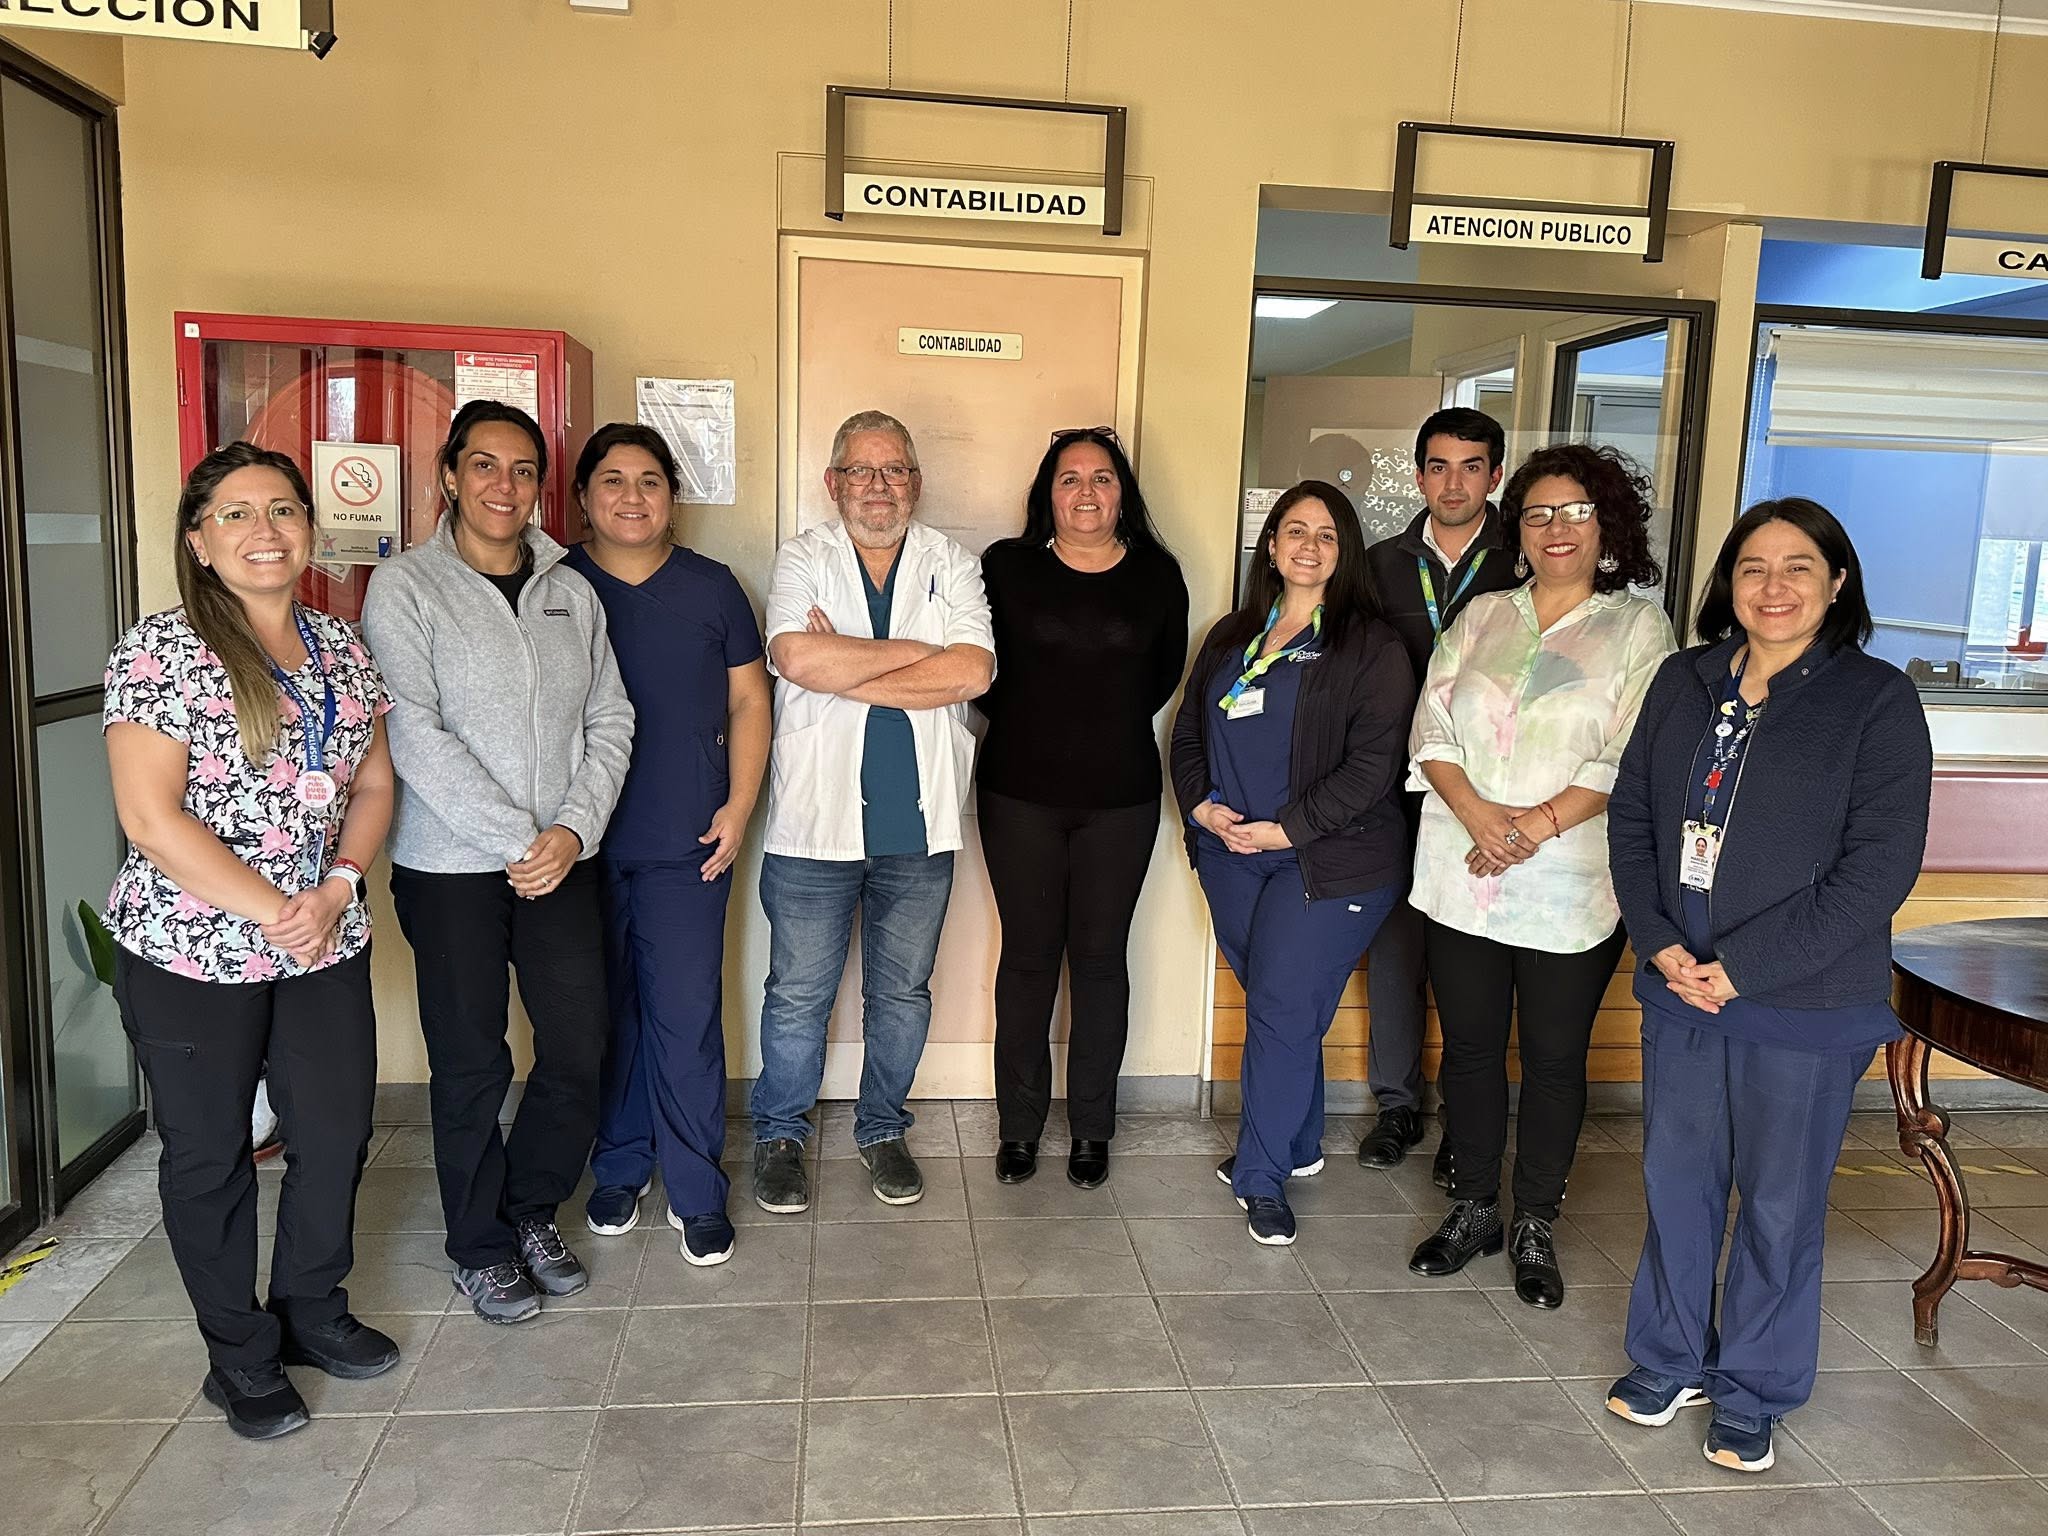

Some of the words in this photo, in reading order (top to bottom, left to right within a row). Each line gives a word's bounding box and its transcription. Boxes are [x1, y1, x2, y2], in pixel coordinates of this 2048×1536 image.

[863, 184, 1086, 216] CONTABILIDAD
[1427, 215, 1534, 240] ATENCION
[1541, 222, 1632, 245] PUBLICO
[918, 334, 1002, 353] CONTABILIDAD
[333, 513, 347, 521] NO
[350, 514, 382, 522] FUMAR
[300, 700, 311, 716] SAN
[306, 717, 314, 728] DE
[308, 729, 319, 767] HOSPITAL
